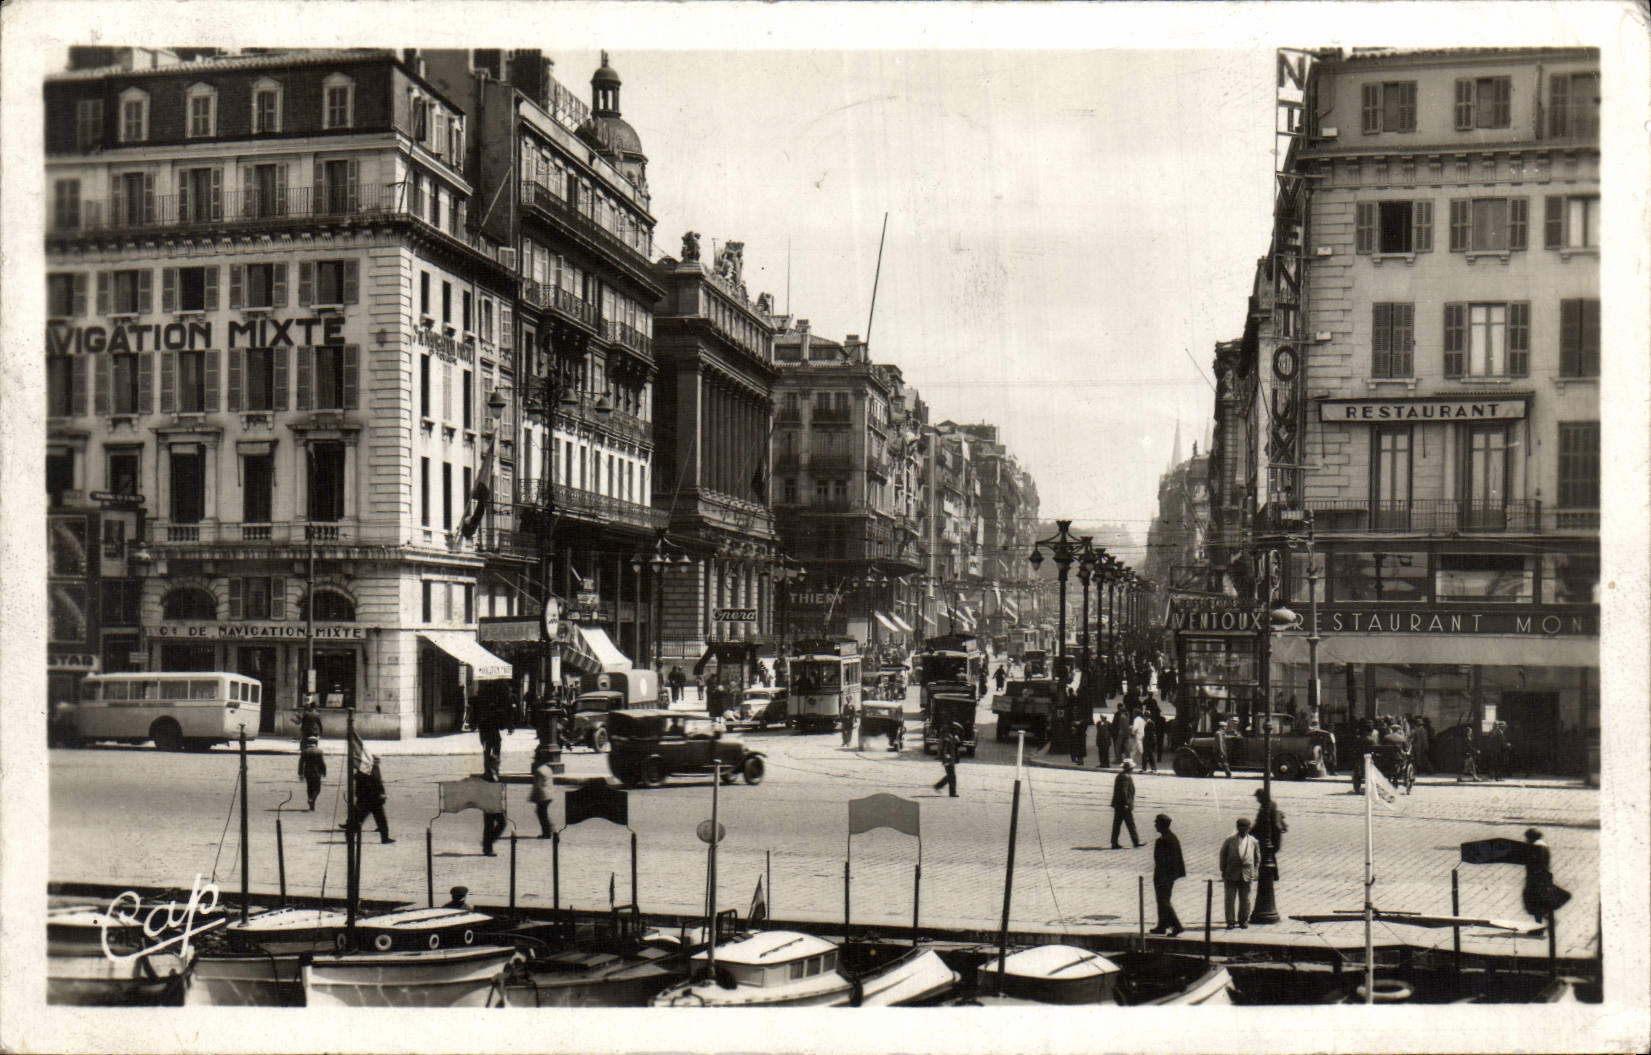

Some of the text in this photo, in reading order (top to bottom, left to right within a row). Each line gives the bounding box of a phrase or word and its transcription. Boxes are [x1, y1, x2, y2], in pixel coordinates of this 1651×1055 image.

[229, 317, 346, 348] MIXTE
[1345, 402, 1500, 419] RESTAURANT
[1175, 611, 1262, 630] VENTOUX
[1292, 611, 1484, 633] RESTAURANT
[188, 626, 208, 637] DE
[218, 625, 306, 637] NAVIGATION
[315, 627, 362, 638] MIXTE
